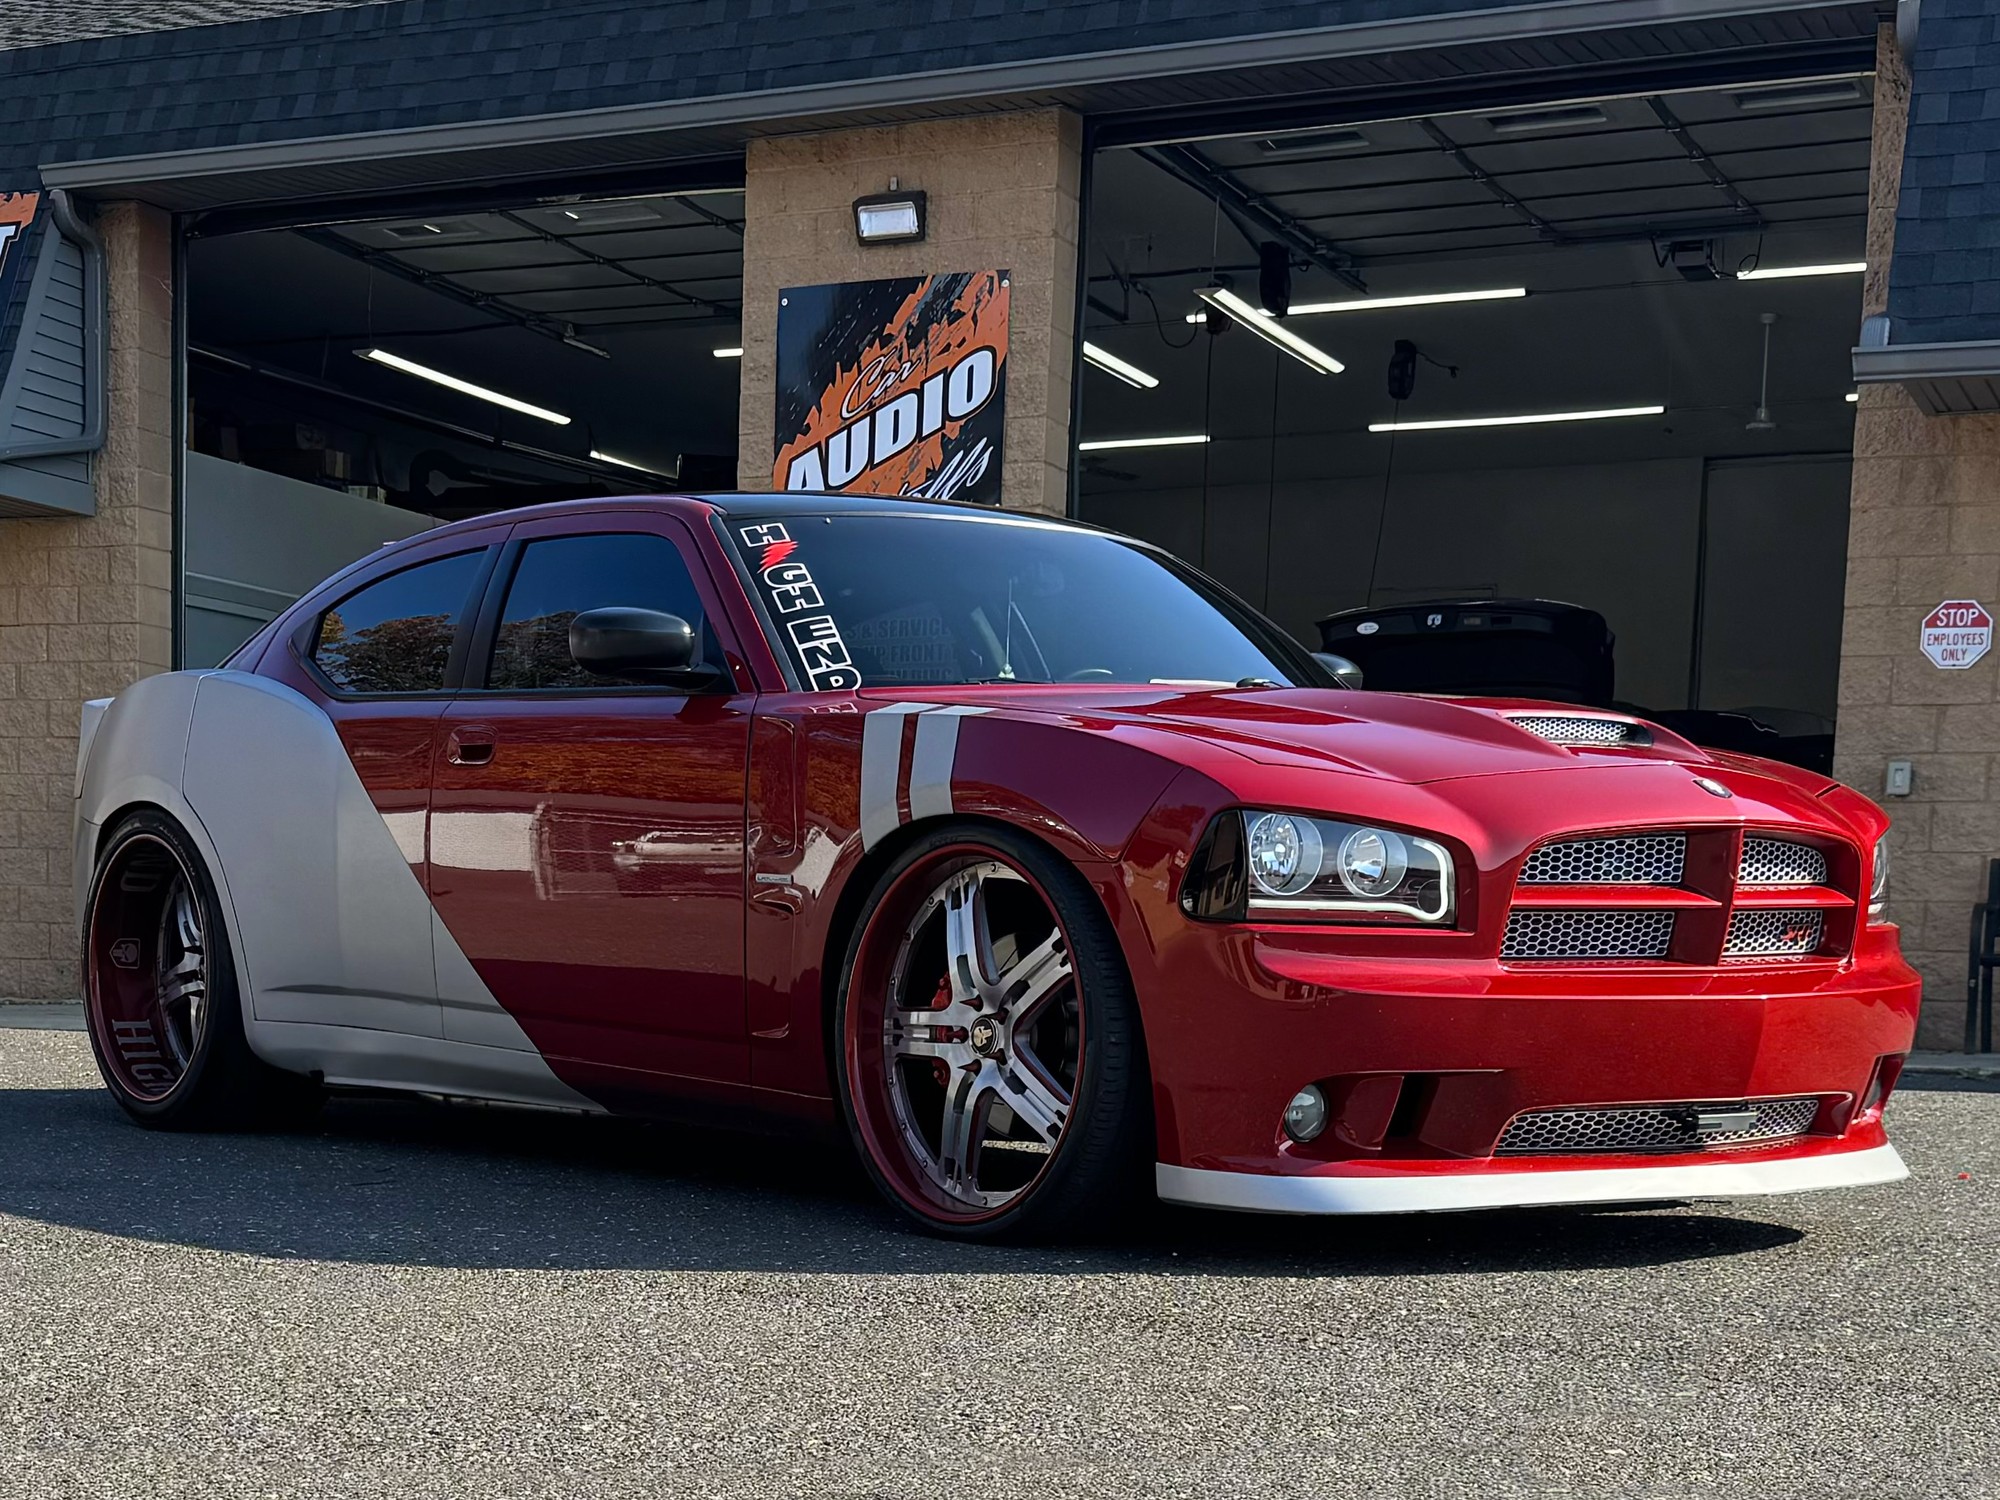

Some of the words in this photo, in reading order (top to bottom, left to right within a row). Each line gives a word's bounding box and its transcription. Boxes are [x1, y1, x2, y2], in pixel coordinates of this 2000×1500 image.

[841, 349, 922, 419] Car
[786, 347, 995, 491] AUDIO
[1936, 608, 1980, 627] STOP
[786, 614, 863, 692] END
[1926, 633, 1985, 647] EMPLOYEES
[1941, 648, 1968, 662] ONLY
